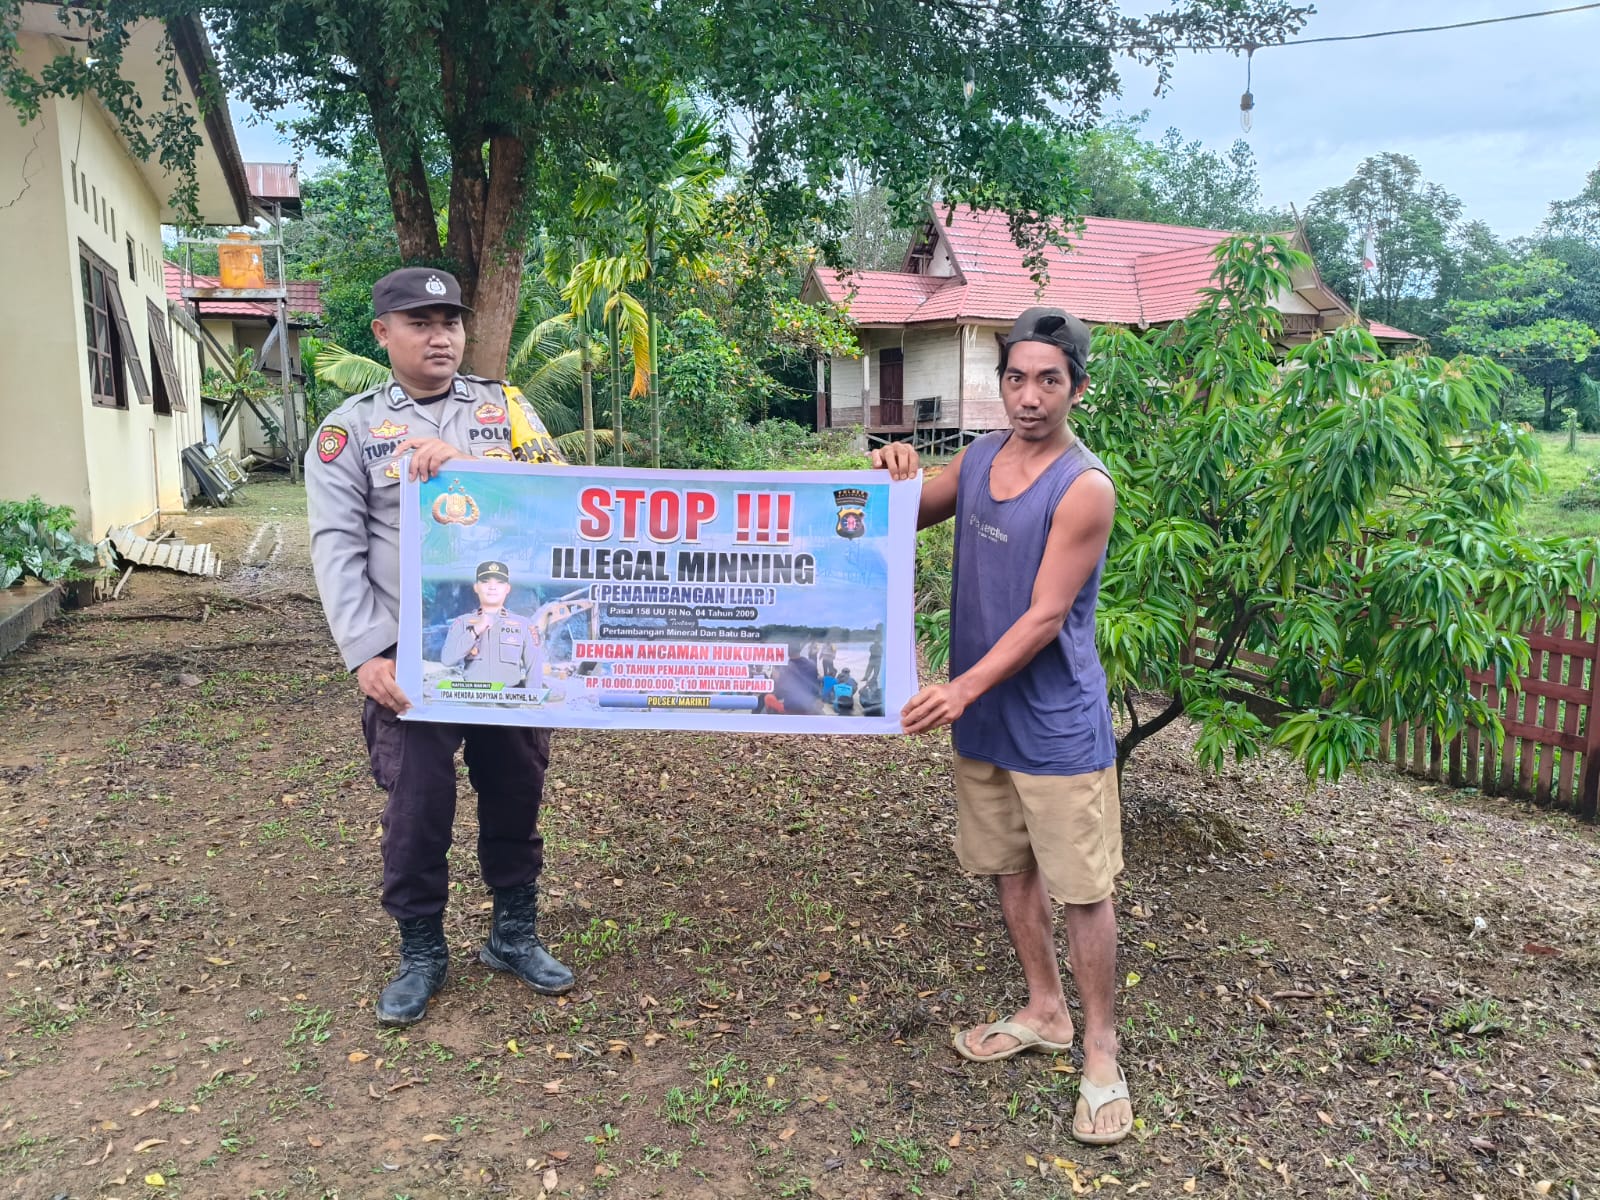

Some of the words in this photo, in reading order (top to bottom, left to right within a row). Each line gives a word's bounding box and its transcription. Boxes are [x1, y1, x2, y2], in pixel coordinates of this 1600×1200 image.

[579, 488, 717, 541] STOP
[736, 492, 792, 543] !!!
[552, 547, 669, 581] ILLEGAL
[678, 551, 814, 584] MINNING
[609, 607, 633, 616] Pasal
[636, 607, 651, 616] 158
[653, 608, 666, 616] UU
[668, 608, 677, 616] RI
[679, 608, 693, 617] No.
[695, 609, 706, 617] 04
[708, 609, 733, 618] Tahun
[735, 610, 755, 618] 2009
[602, 627, 664, 637] Pertambangan
[666, 628, 698, 637] Mineral
[700, 629, 717, 637] Dan
[719, 630, 738, 638] Batu
[740, 630, 760, 638] Bara
[575, 643, 634, 659] DENGAN
[637, 645, 709, 660] ANCAMAN
[712, 646, 785, 662] HUKUMAN
[613, 664, 623, 675] 10
[625, 664, 656, 675] TAHUN
[657, 665, 696, 676] PENJARA
[697, 665, 716, 676] DAN
[717, 666, 747, 676] DENDA
[699, 680, 731, 690] MILYAR
[647, 696, 677, 706] POLSEK
[678, 696, 711, 707] MARIKIT
